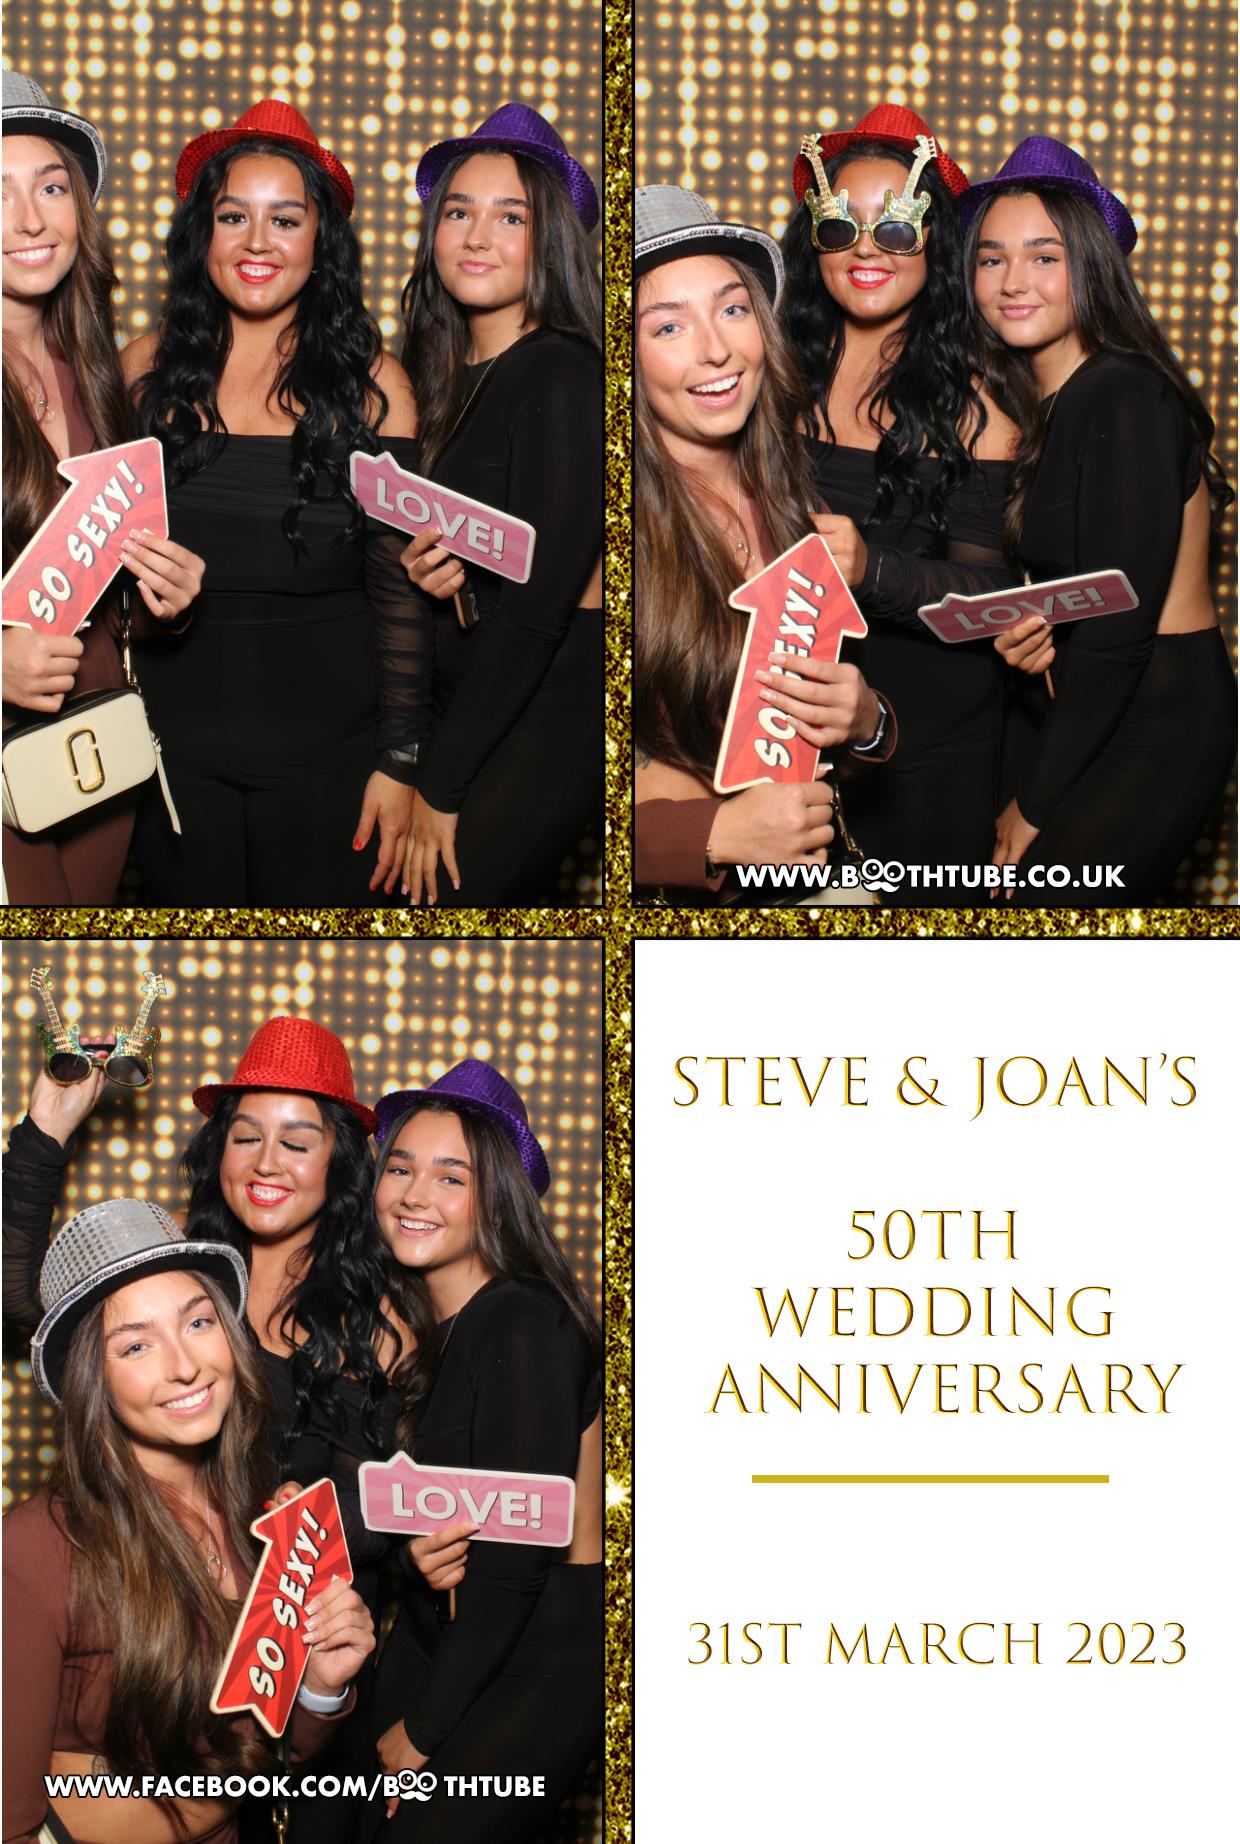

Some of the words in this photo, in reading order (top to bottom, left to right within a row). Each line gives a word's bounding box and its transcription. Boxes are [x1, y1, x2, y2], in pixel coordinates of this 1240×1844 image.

[28, 566, 73, 624] SO
[67, 459, 145, 569] SEXY!
[377, 477, 505, 561] LOVE!
[769, 566, 826, 681] EXY!
[954, 587, 1107, 632] LOVE!
[754, 706, 798, 769] SO
[391, 1483, 544, 1530] LOVE!
[248, 1636, 286, 1698] SO
[272, 1507, 328, 1630] SEXY!
